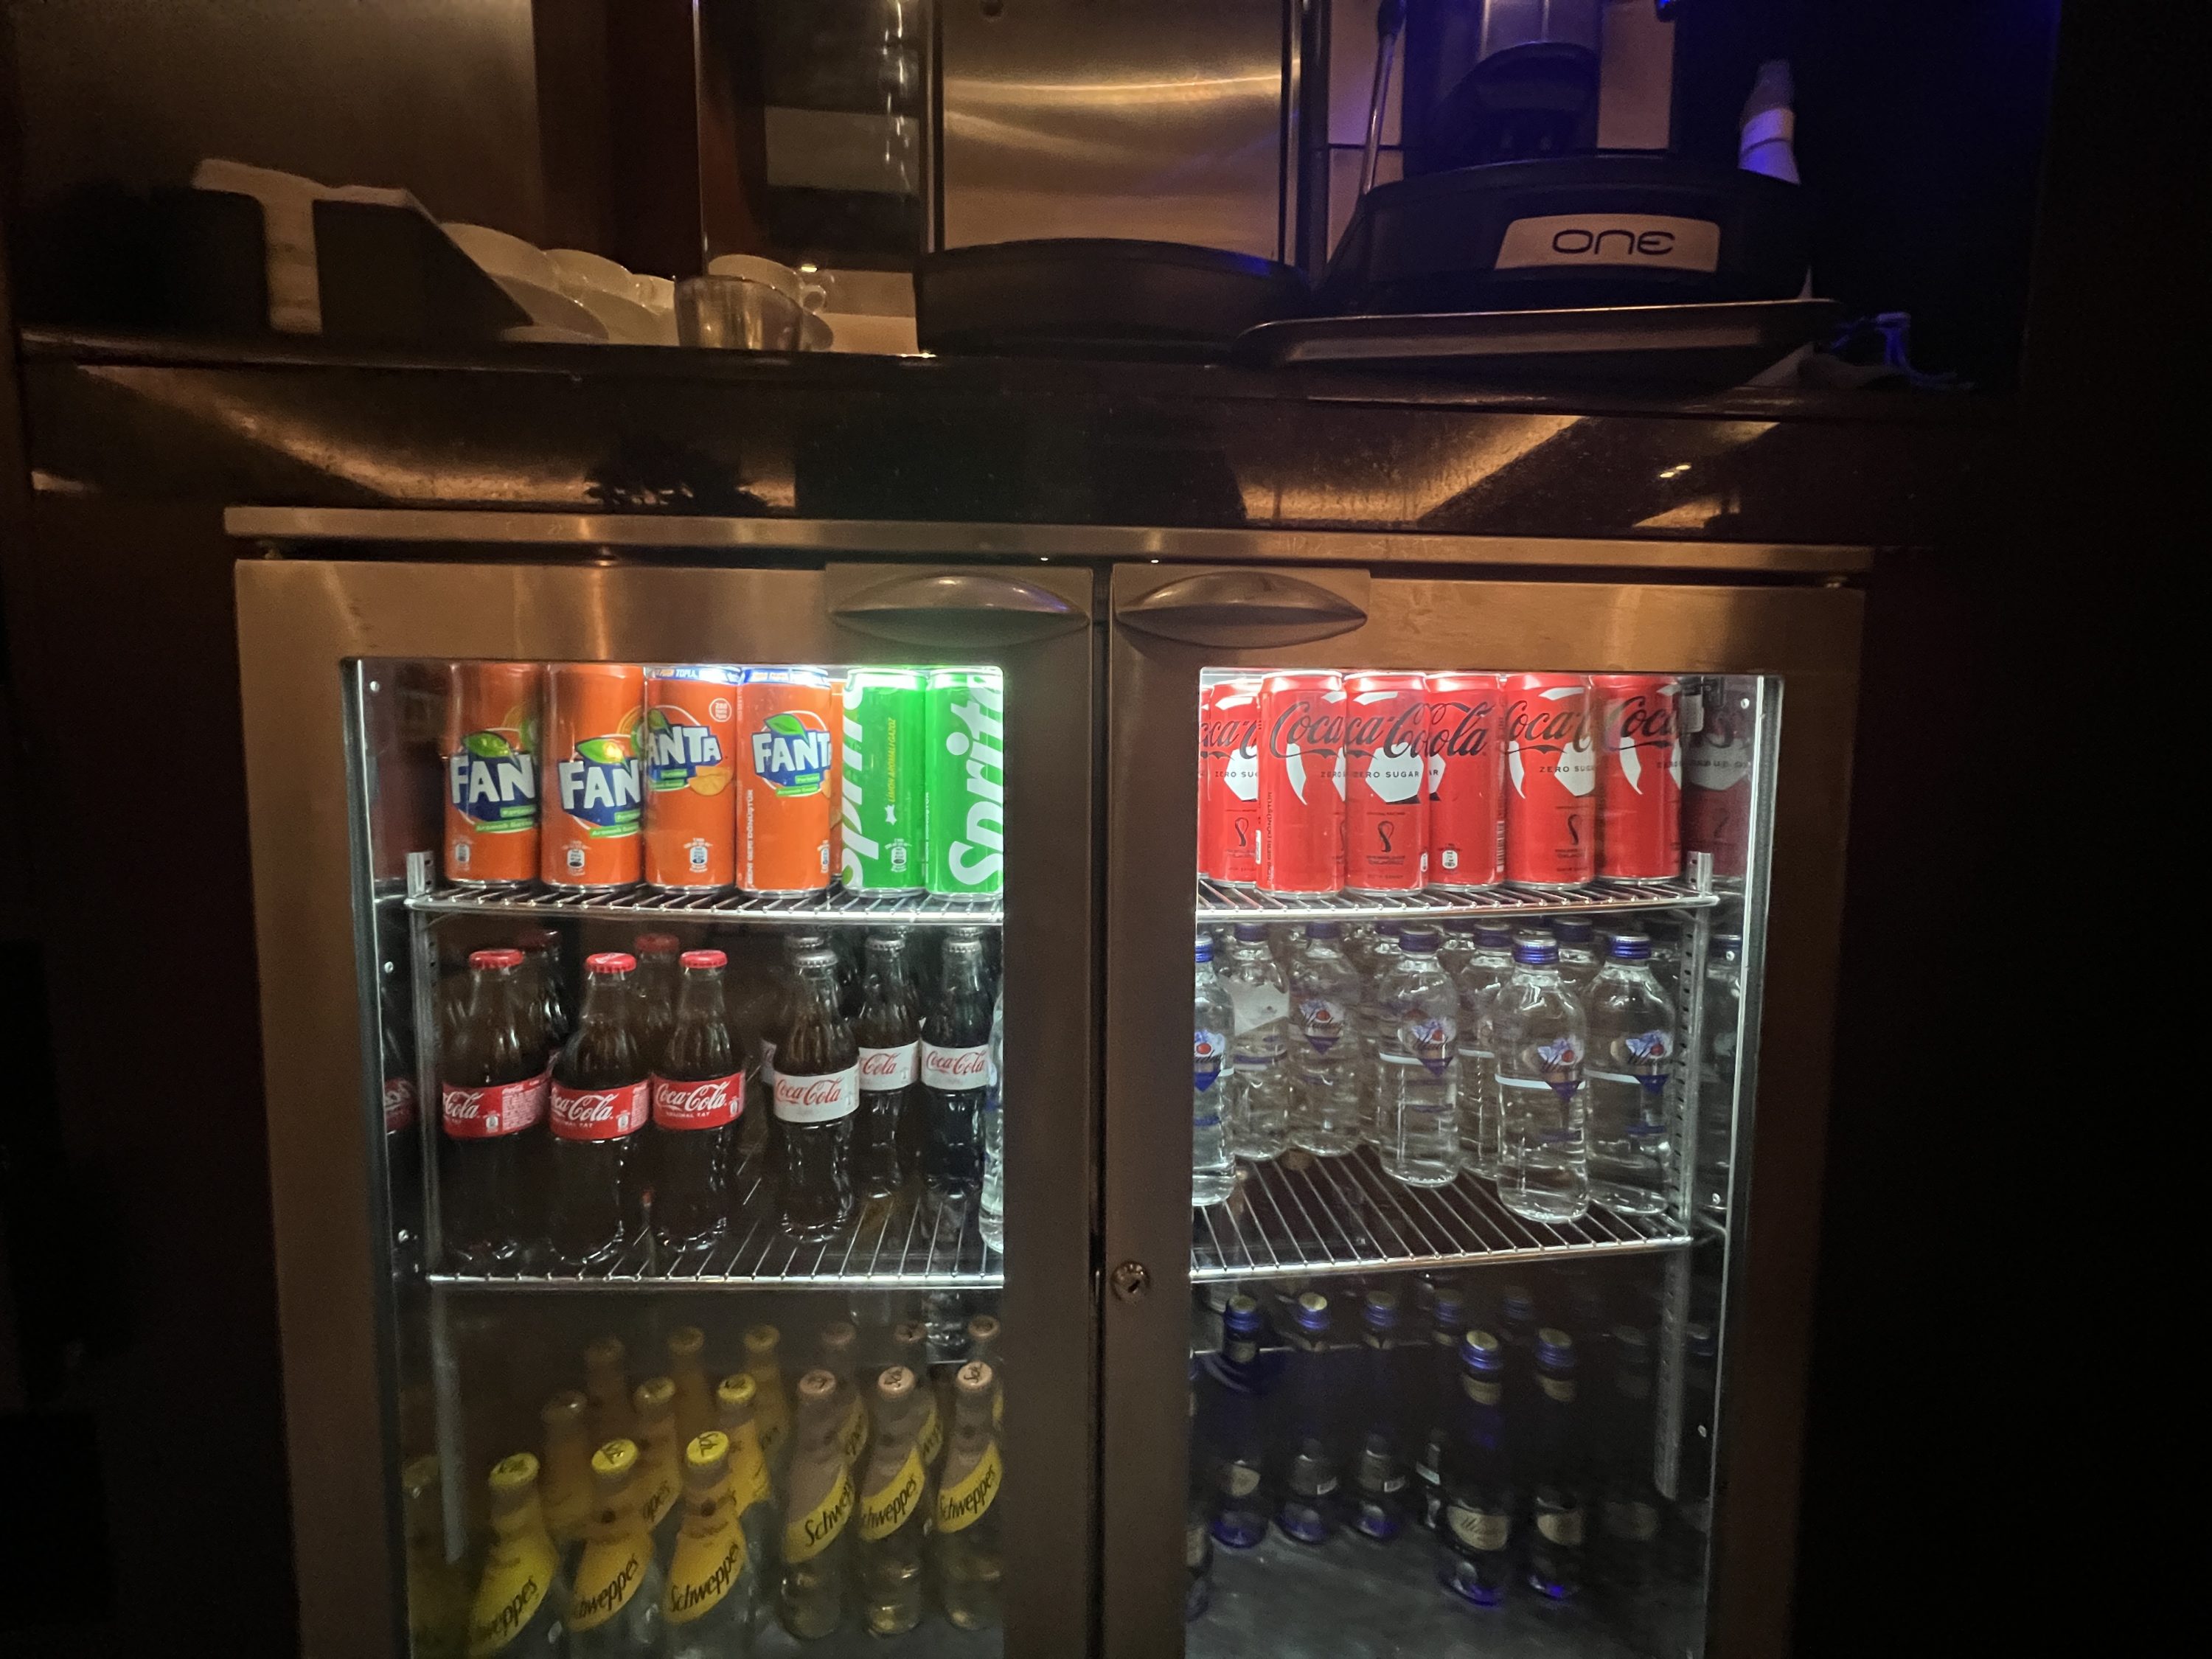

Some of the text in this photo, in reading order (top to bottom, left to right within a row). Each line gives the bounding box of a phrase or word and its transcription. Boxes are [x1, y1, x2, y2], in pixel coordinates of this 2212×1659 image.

[1385, 770, 1420, 779] SUGAR
[1539, 765, 1571, 773] ZERO
[925, 1050, 987, 1076] Coca-Cola
[655, 1080, 730, 1113] Coca-Cola
[776, 1077, 844, 1106] Coca-Cola
